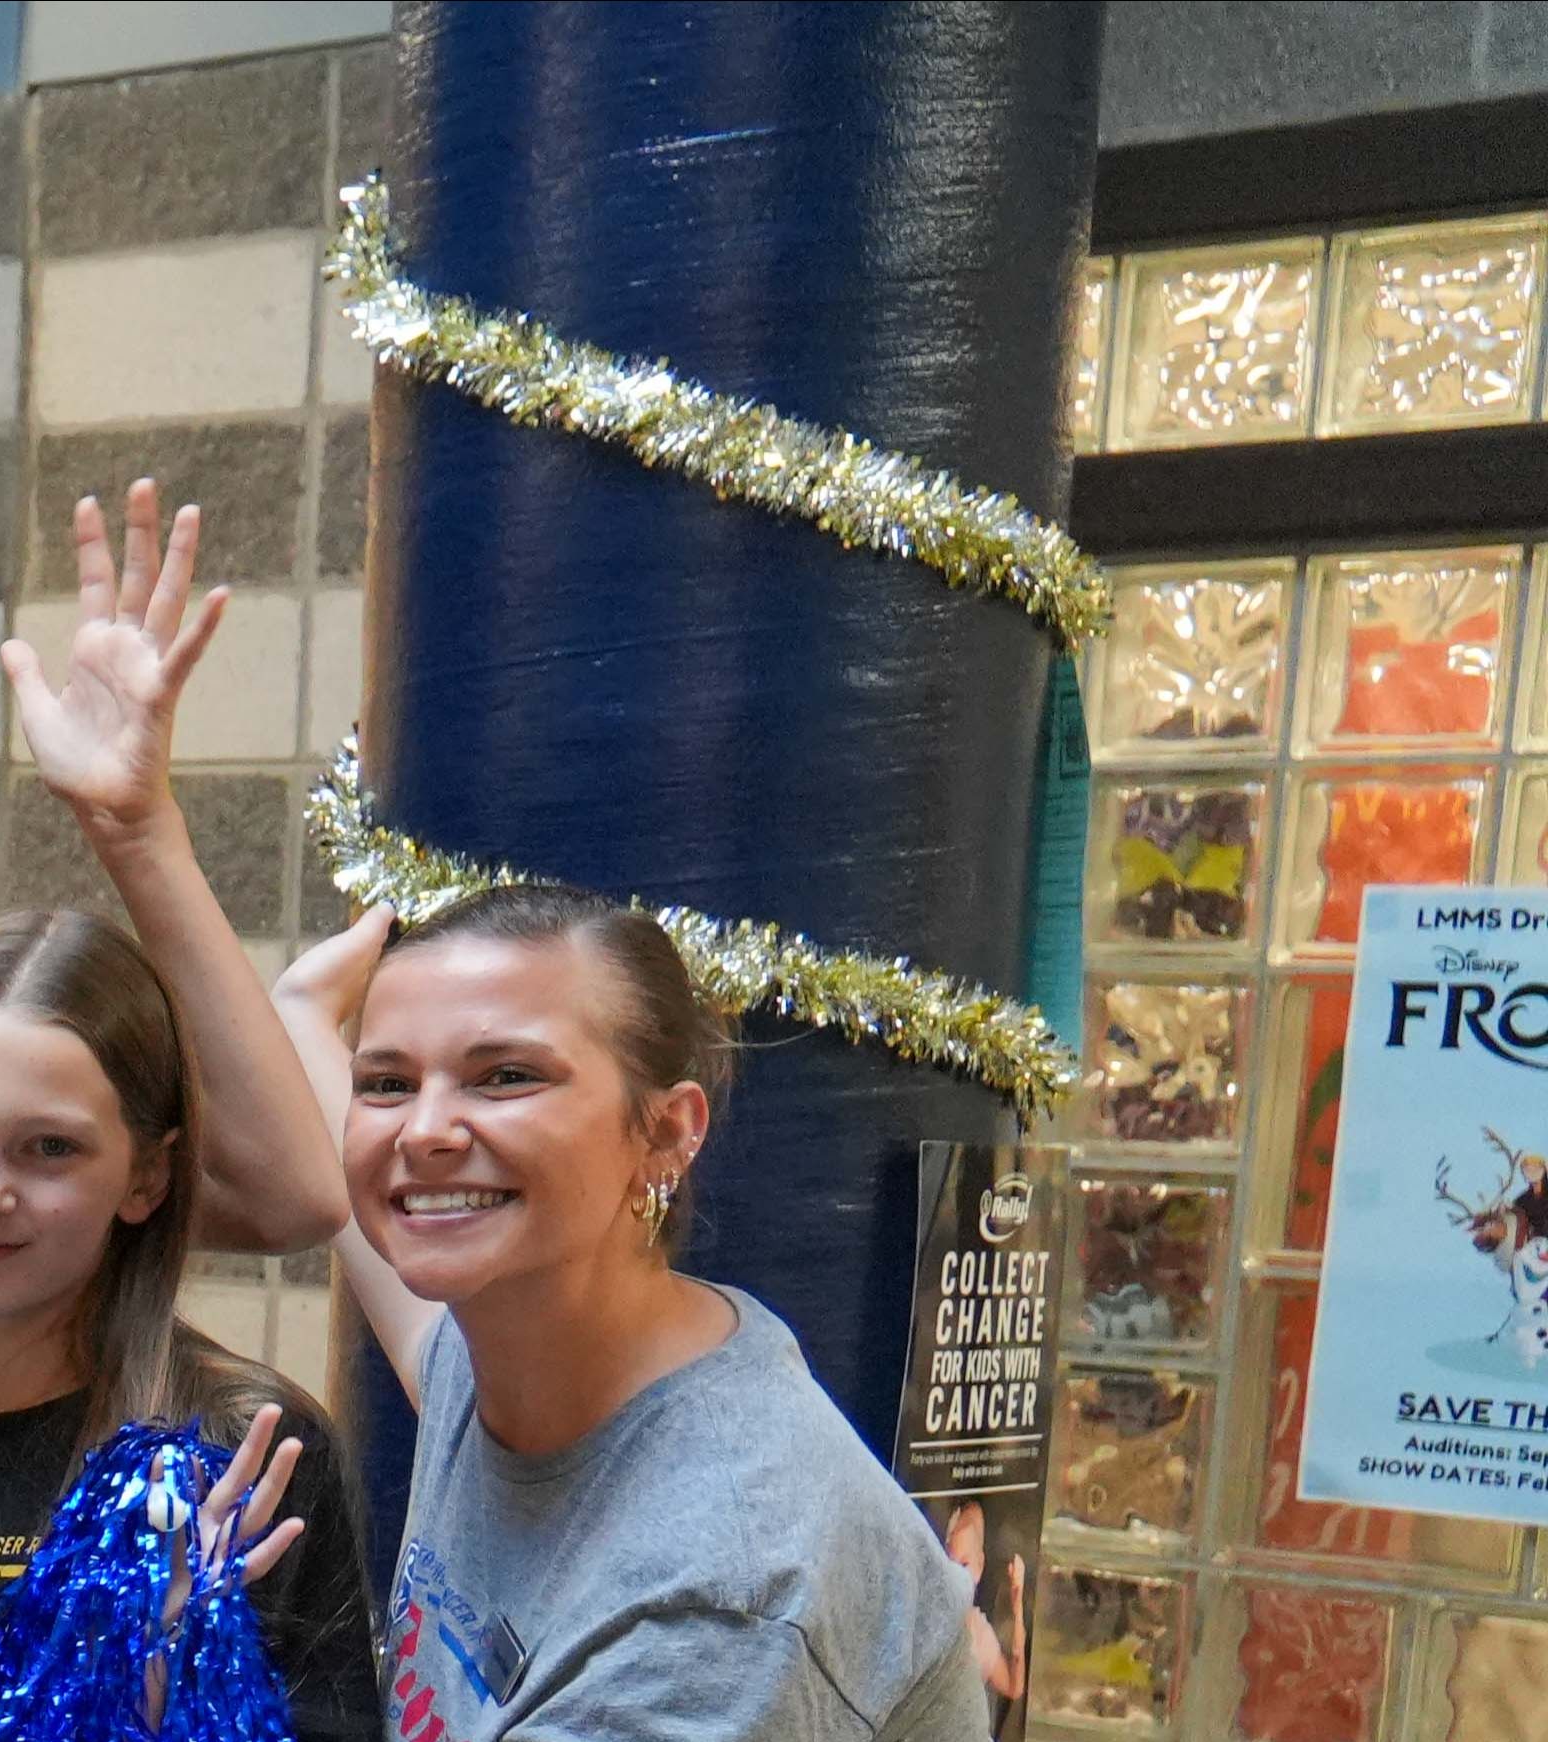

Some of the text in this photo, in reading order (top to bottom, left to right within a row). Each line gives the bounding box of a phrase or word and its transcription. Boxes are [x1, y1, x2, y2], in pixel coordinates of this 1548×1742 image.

[1417, 907, 1501, 930] LMMS
[941, 1251, 1050, 1296] COLLECT
[936, 1298, 1046, 1346] CHANGE
[931, 1348, 1042, 1384] FOR KIDS WITH
[925, 1382, 1037, 1433] CANCER
[1398, 1391, 1494, 1424] SAVE
[1404, 1435, 1511, 1461] Auditions:
[1358, 1456, 1426, 1479] SHOW
[1430, 1464, 1511, 1487] DATES:
